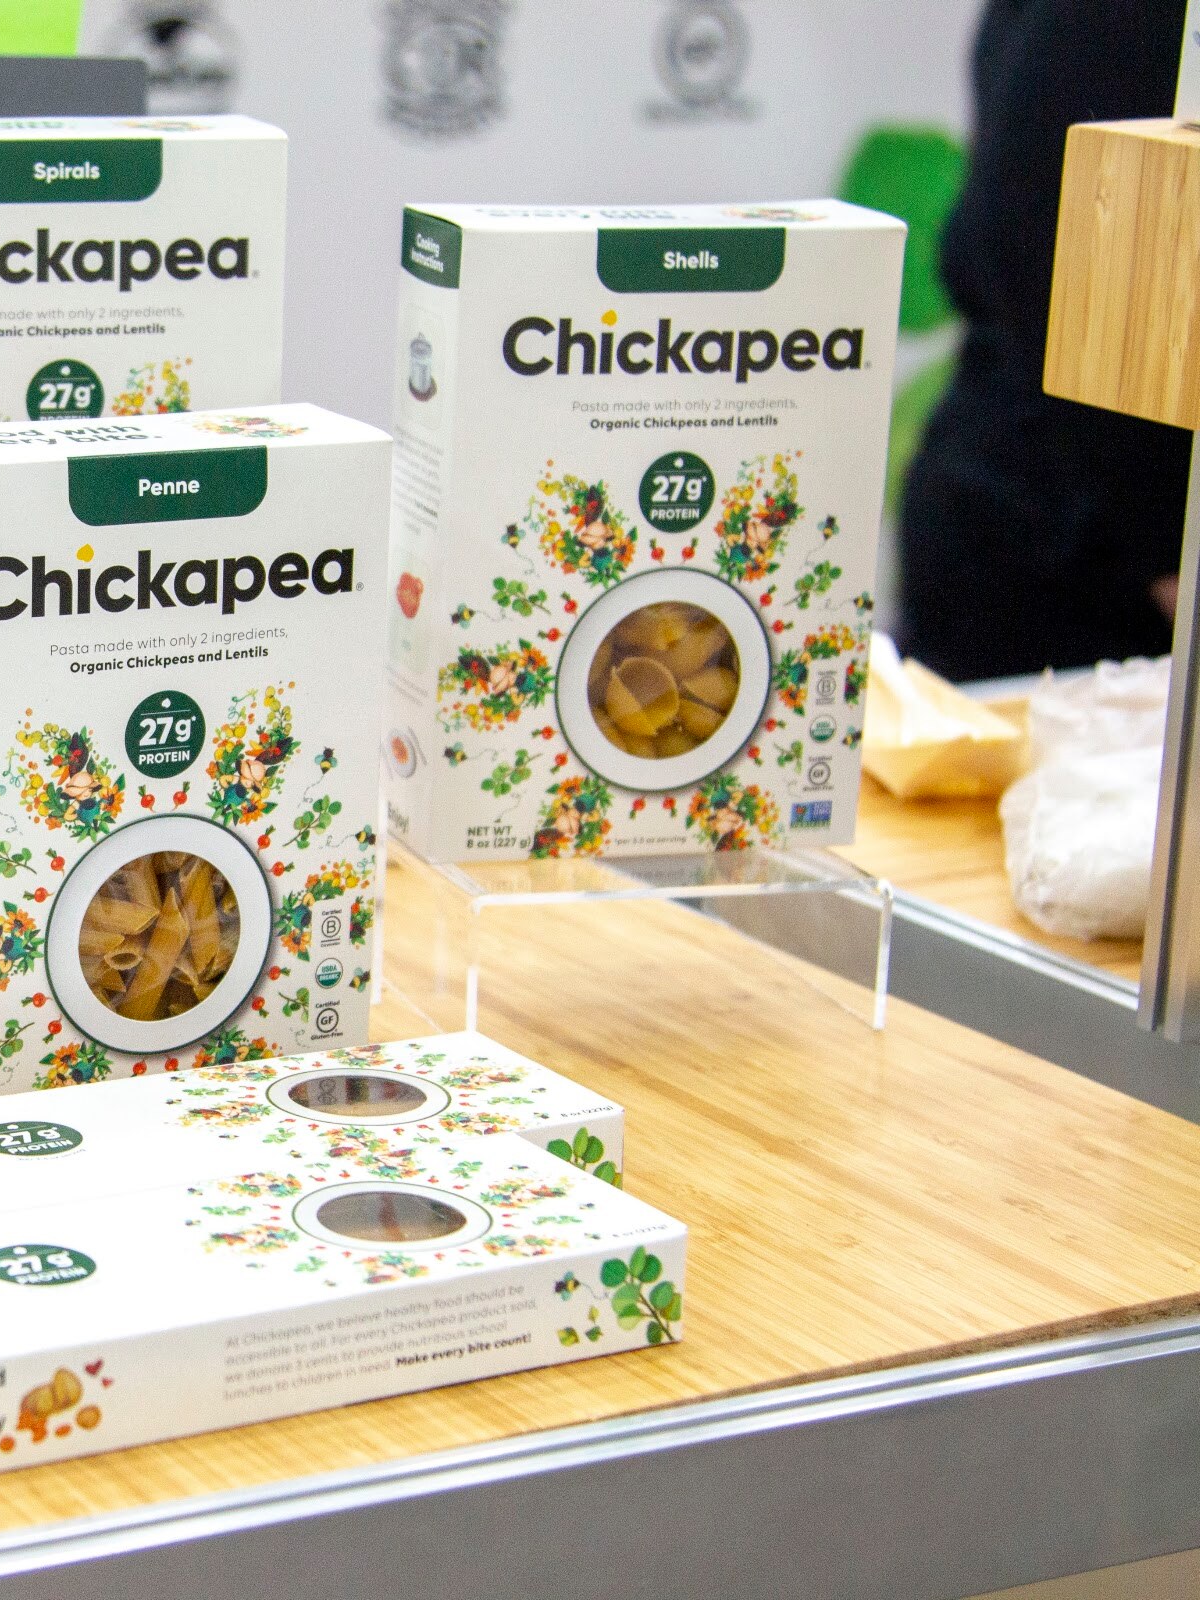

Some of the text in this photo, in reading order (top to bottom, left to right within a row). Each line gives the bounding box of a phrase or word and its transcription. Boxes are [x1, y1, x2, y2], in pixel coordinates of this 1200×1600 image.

[33, 161, 100, 183] Spirals
[663, 252, 719, 270] Shells
[37, 309, 65, 320] with
[68, 309, 94, 321] only
[98, 307, 106, 318] 2
[27, 326, 93, 338] Chickpeas
[96, 325, 121, 335] and
[123, 323, 166, 335] Lentils
[502, 310, 864, 383] Chickapea
[572, 401, 609, 413] Pasta
[613, 401, 650, 412] made
[654, 400, 681, 411] with
[685, 399, 711, 412] only
[714, 400, 722, 410] 2
[54, 425, 141, 435] with
[590, 415, 778, 432] Organic Chickpeas and Lentils
[67, 433, 162, 442] bite.
[138, 477, 200, 497] Penne
[651, 509, 700, 520] PROTEIN
[50, 627, 288, 656] Pasta made with only 2 ingredients,
[70, 646, 269, 675] Organic Chickpeas and Lentils
[138, 750, 190, 765] PROTEIN
[467, 825, 512, 836] NET WT
[477, 840, 490, 848] oz
[326, 920, 337, 934] B
[321, 1015, 334, 1025] GF
[8, 1139, 74, 1154] PROTEIN
[396, 1353, 428, 1367] Make
[432, 1347, 464, 1359] every
[468, 1341, 491, 1353] bite
[494, 1332, 531, 1349] count!
